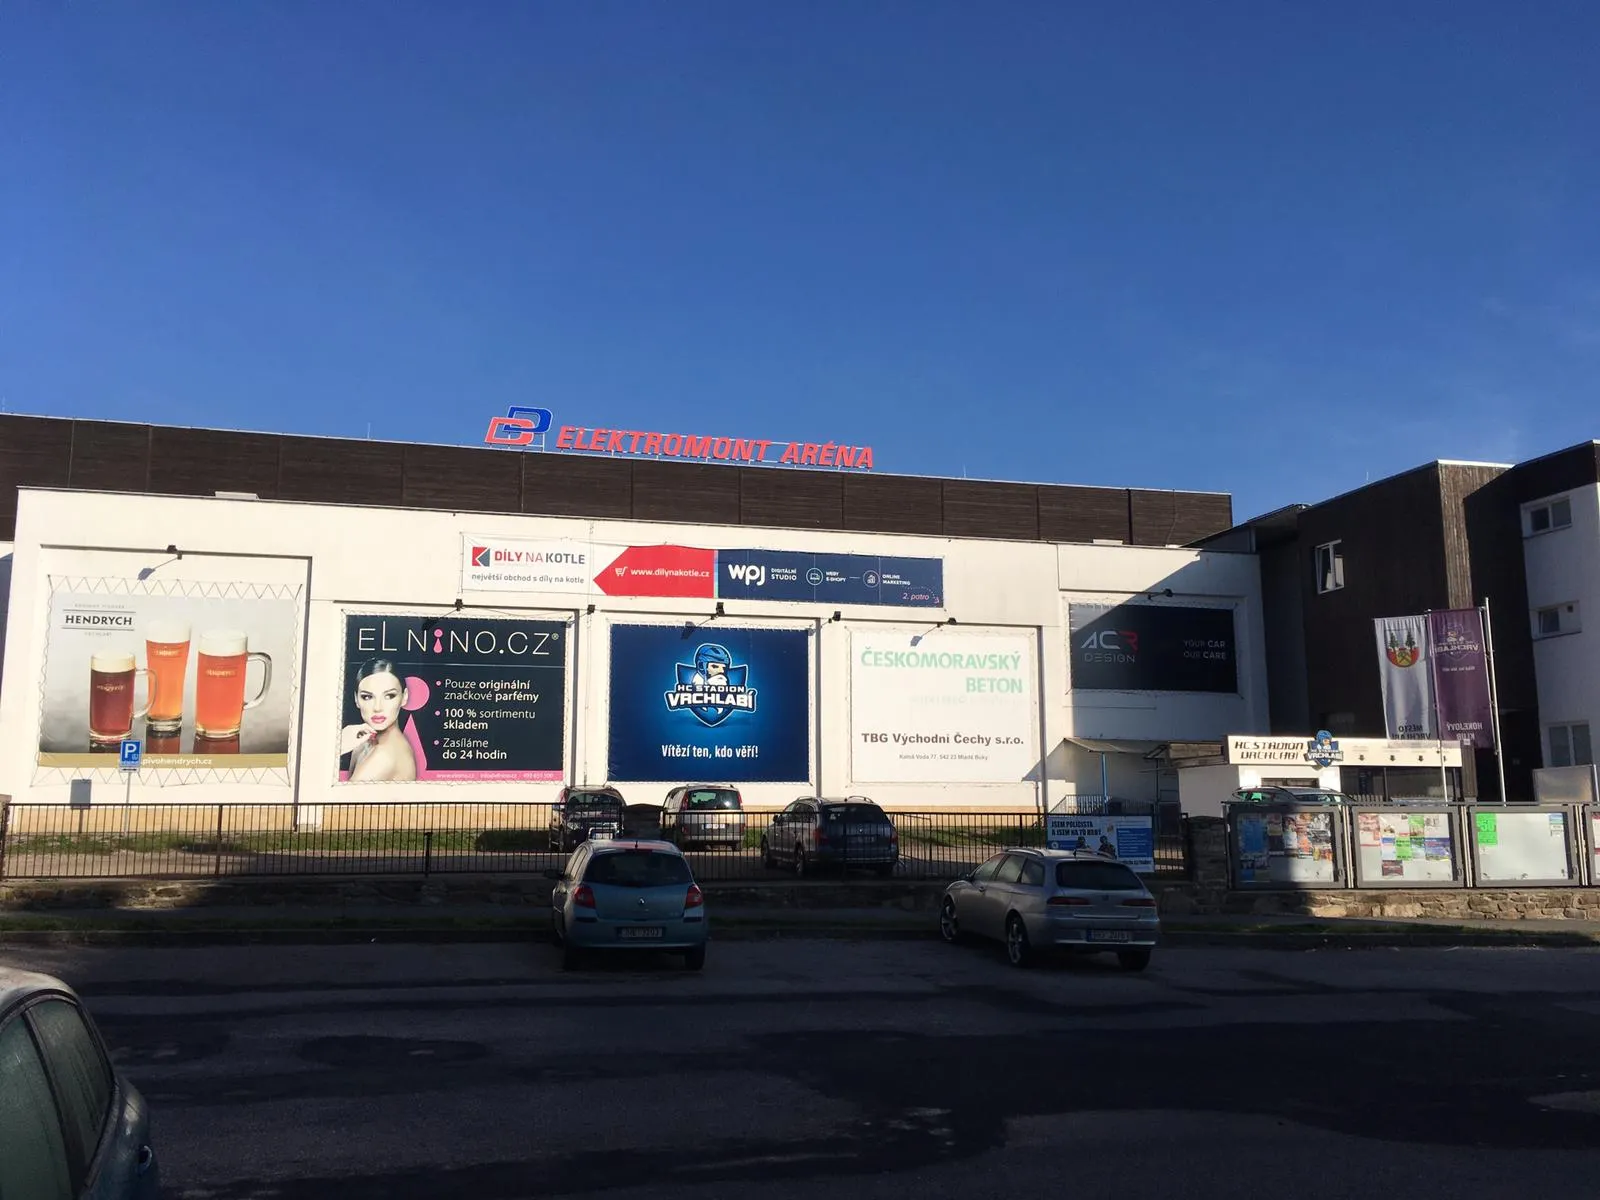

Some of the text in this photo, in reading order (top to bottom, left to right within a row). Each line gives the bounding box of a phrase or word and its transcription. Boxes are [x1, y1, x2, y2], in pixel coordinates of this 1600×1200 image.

[556, 425, 874, 469] ELEKTROMONT ARÉNA
[494, 548, 586, 565] DÍLY NA KOTLE
[471, 573, 503, 583] největší
[503, 574, 532, 583] obchod
[539, 574, 553, 584] díly
[565, 576, 585, 584] kotle
[630, 568, 710, 578] www.dilynakotle.cz
[902, 592, 930, 602] 2. patro
[65, 615, 133, 626] HENDRYCH
[358, 621, 398, 651] EL
[1207, 640, 1226, 648] CAR
[861, 646, 1021, 670] ČESKOMORAVSKÝ
[1084, 652, 1135, 663] DESIGN
[1202, 651, 1226, 660] CARE
[444, 679, 531, 691] Pouze originální
[966, 677, 1022, 693] BETON
[444, 691, 539, 703] značkové parfémy
[667, 690, 754, 709] VRCHLABÍ
[444, 709, 536, 719] 100 % sortimentu
[443, 720, 488, 730] skladem
[443, 738, 489, 748] Zasíláme
[862, 732, 1024, 746] TBG Východní Čechy s.r.o.
[124, 743, 137, 759] P
[442, 750, 507, 760] do 24 hodin
[661, 744, 759, 759] Vítězí ten, kdo věří!
[1066, 820, 1094, 828] POLICISTA
